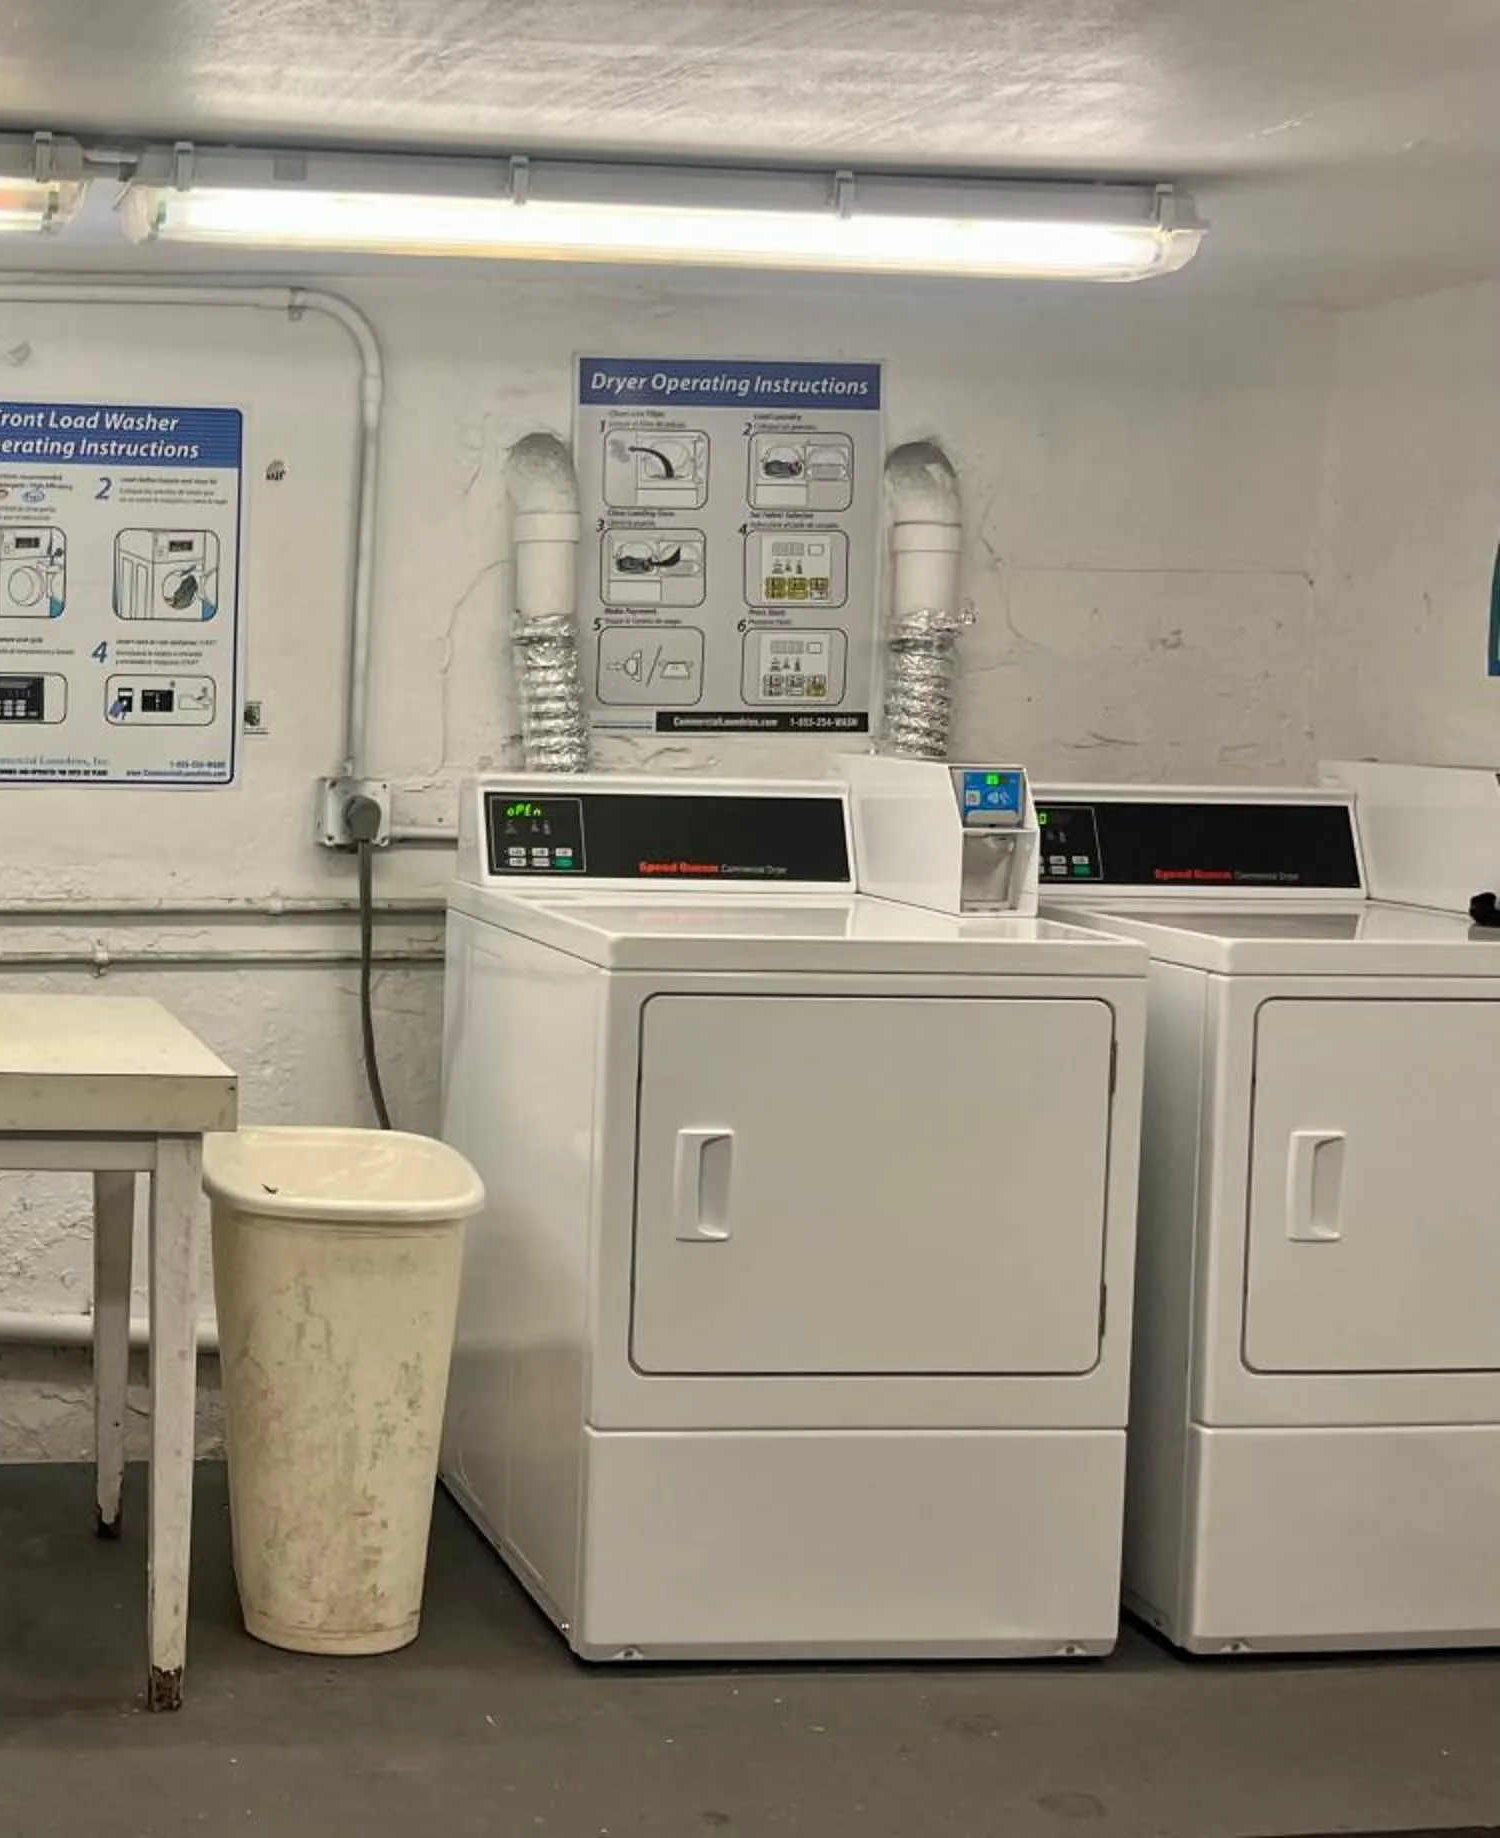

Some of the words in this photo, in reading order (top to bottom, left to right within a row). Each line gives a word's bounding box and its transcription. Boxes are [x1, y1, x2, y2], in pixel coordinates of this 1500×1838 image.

[591, 372, 647, 393] Dryer
[651, 373, 750, 396] Operating
[754, 375, 869, 396] Instructions
[48, 411, 100, 429] Load
[104, 413, 180, 432] Washer
[742, 422, 753, 436] 2
[80, 438, 200, 459] Instructions
[94, 476, 113, 500] 2
[595, 518, 605, 533] 3
[737, 523, 747, 535] 4
[592, 617, 601, 632] 5
[737, 619, 747, 633] 6
[91, 640, 108, 664] 4
